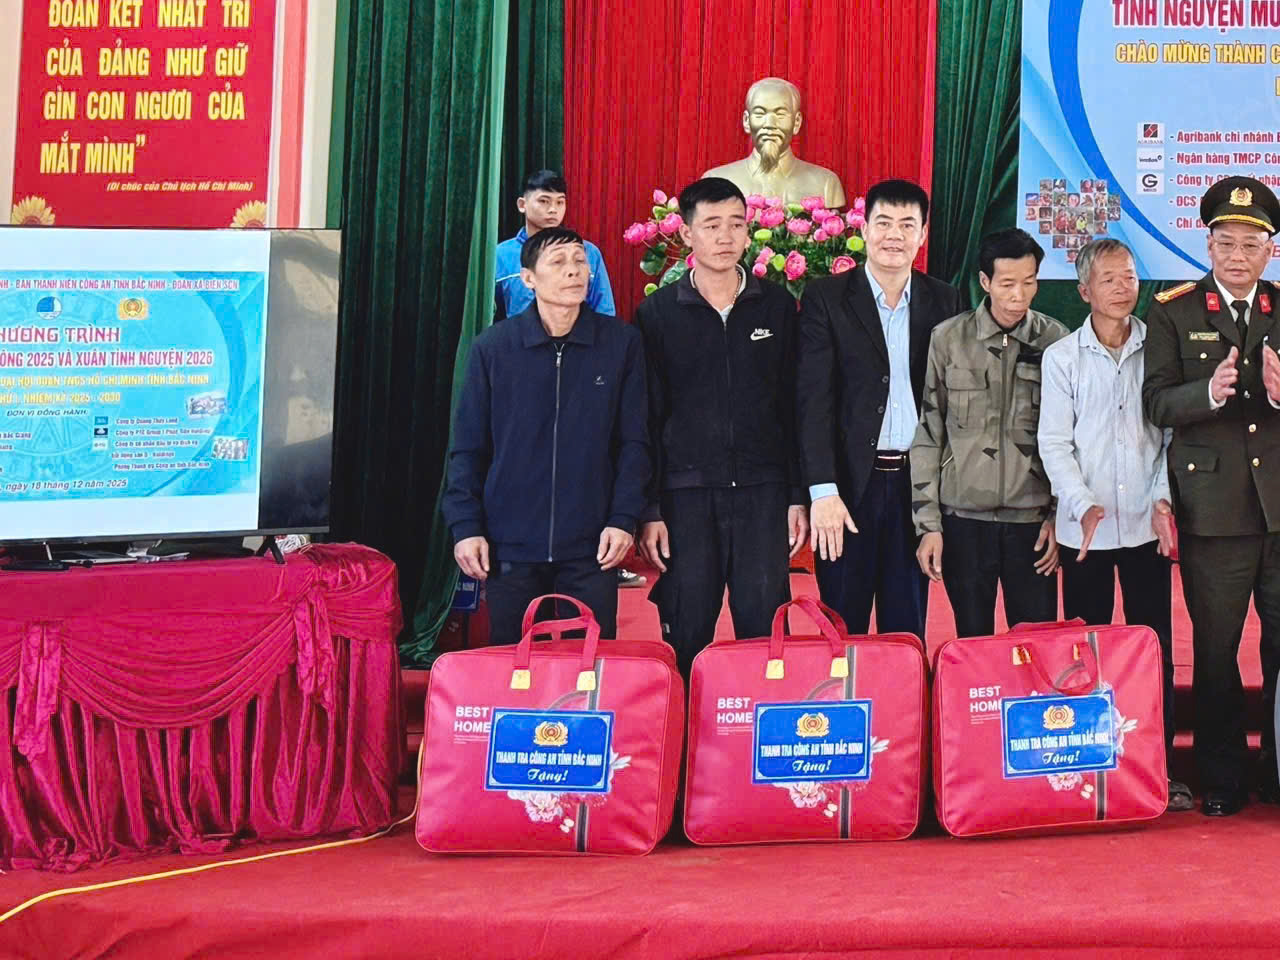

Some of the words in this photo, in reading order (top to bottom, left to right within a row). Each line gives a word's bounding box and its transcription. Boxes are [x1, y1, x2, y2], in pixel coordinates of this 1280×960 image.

[1115, 40, 1158, 64] CHÀO
[1163, 40, 1210, 64] MỪNG
[1214, 40, 1266, 64] THÀNH
[1177, 131, 1222, 143] Agribank
[1225, 131, 1240, 142] chi
[1243, 132, 1273, 143] nhánh
[40, 132, 80, 173] MẮT
[65, 324, 120, 343] TRÌNH
[754, 328, 770, 336] NIKE
[27, 353, 54, 367] 2025
[58, 349, 71, 367] VÀ
[111, 349, 135, 366] TÌNH
[139, 349, 184, 369] NGUYỆN
[186, 351, 213, 365] 2026
[969, 686, 1001, 698] BEST
[718, 697, 751, 709] BEST
[456, 706, 489, 718] BEST
[716, 712, 753, 724] HOME
[454, 721, 491, 733] HOME
[792, 759, 831, 773] Tặng!
